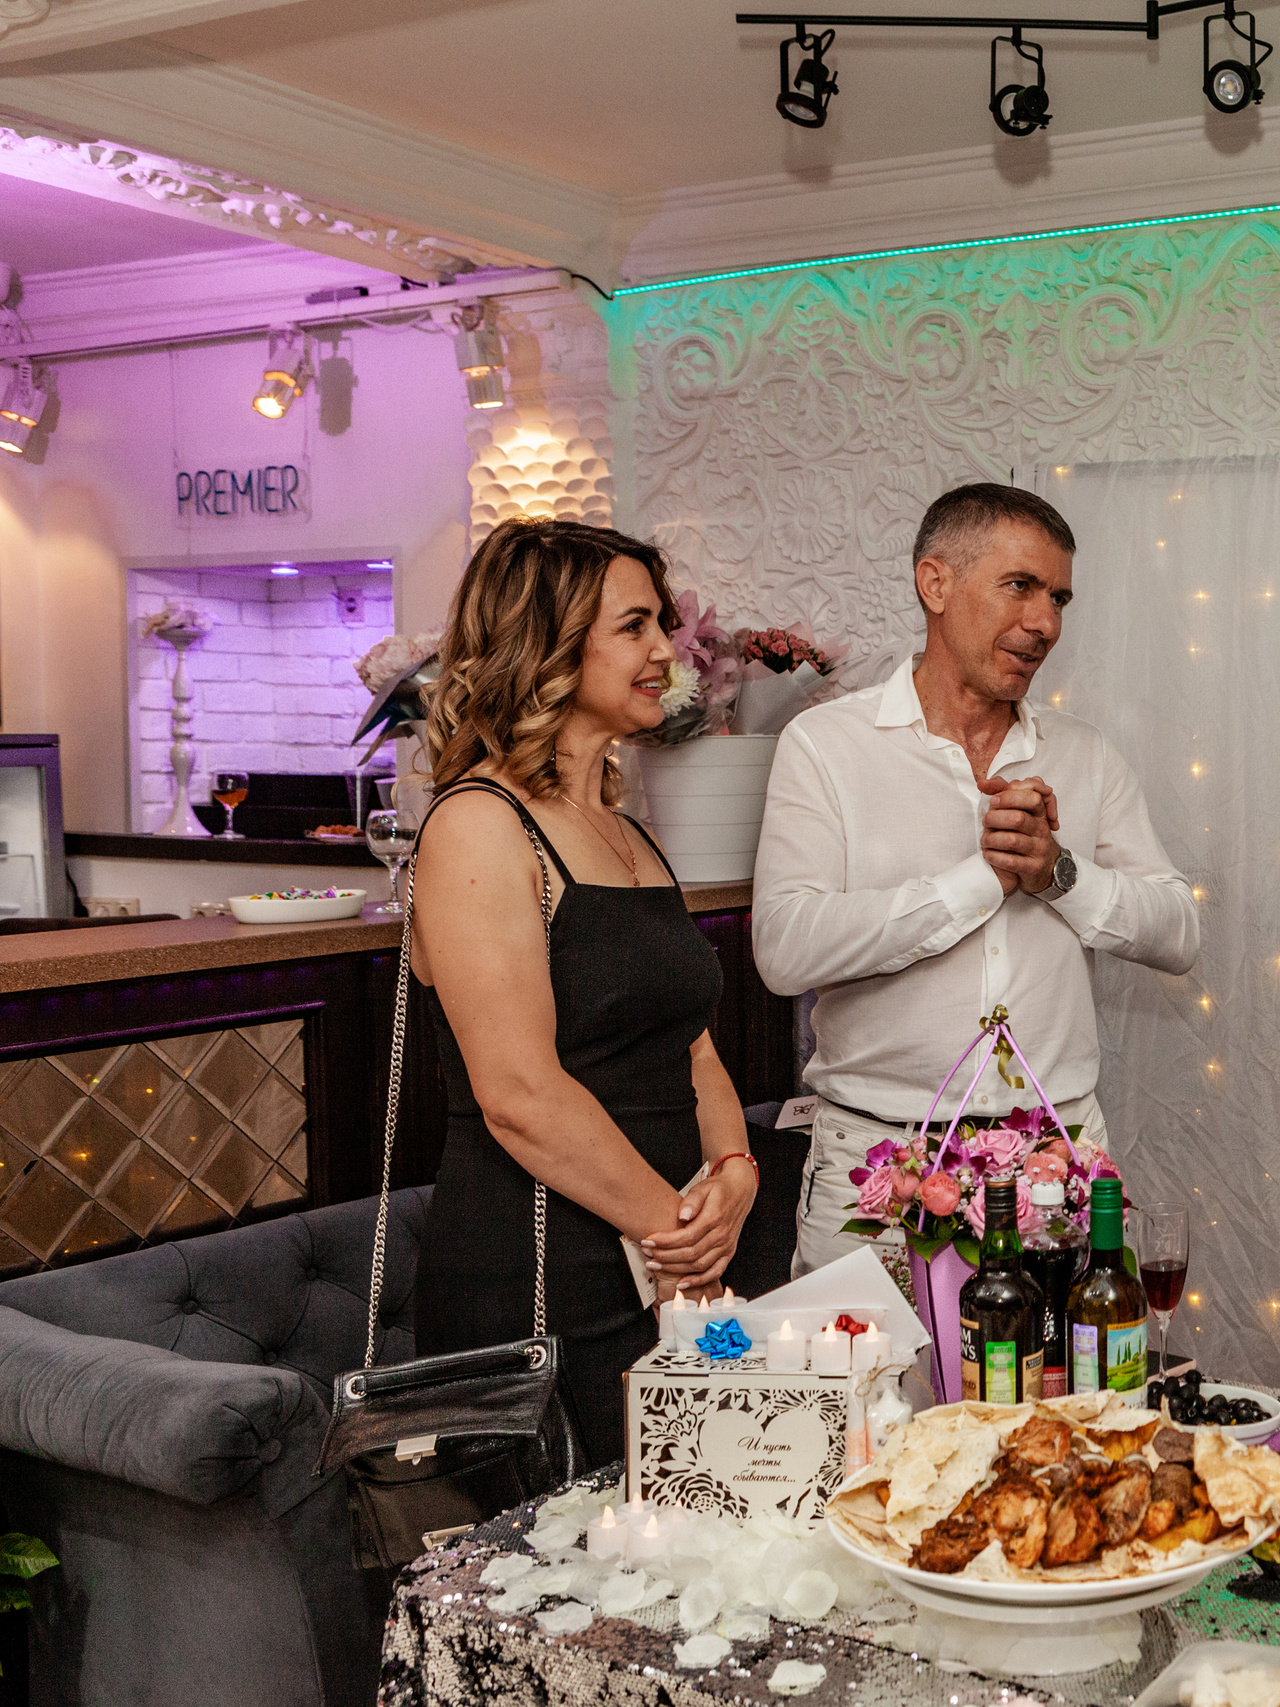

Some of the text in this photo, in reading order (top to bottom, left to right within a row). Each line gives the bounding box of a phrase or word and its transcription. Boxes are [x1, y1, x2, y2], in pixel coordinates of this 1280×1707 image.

[176, 465, 300, 515] PREMIER
[737, 1436, 792, 1455] И пусть
